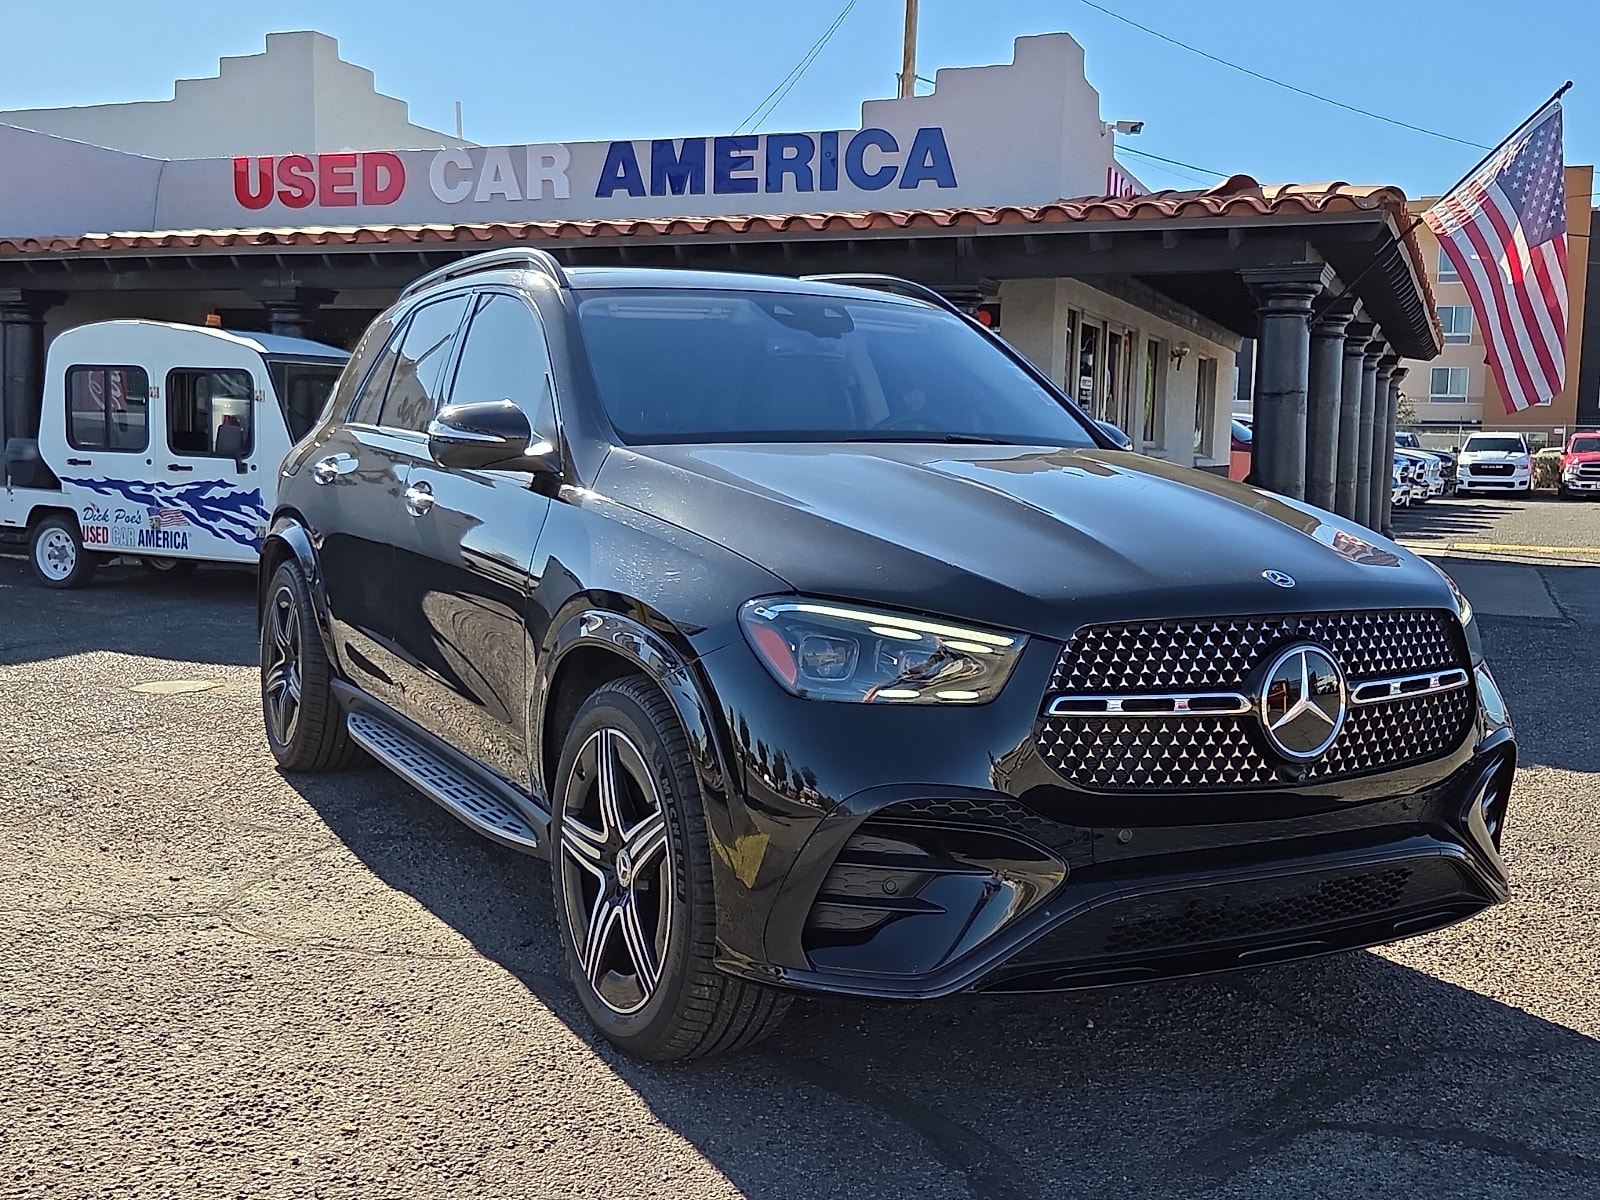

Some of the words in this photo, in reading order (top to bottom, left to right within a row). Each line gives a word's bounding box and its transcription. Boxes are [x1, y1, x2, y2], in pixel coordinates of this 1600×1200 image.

[234, 152, 407, 209] USED
[429, 143, 571, 204] CAR
[595, 127, 958, 197] AMERICA
[82, 525, 109, 544] USED
[112, 526, 136, 547] CAR
[138, 529, 189, 550] AMERICA
[83, 506, 110, 522] Dick
[114, 508, 143, 525] Poe's
[660, 777, 687, 897] MICHELIN
